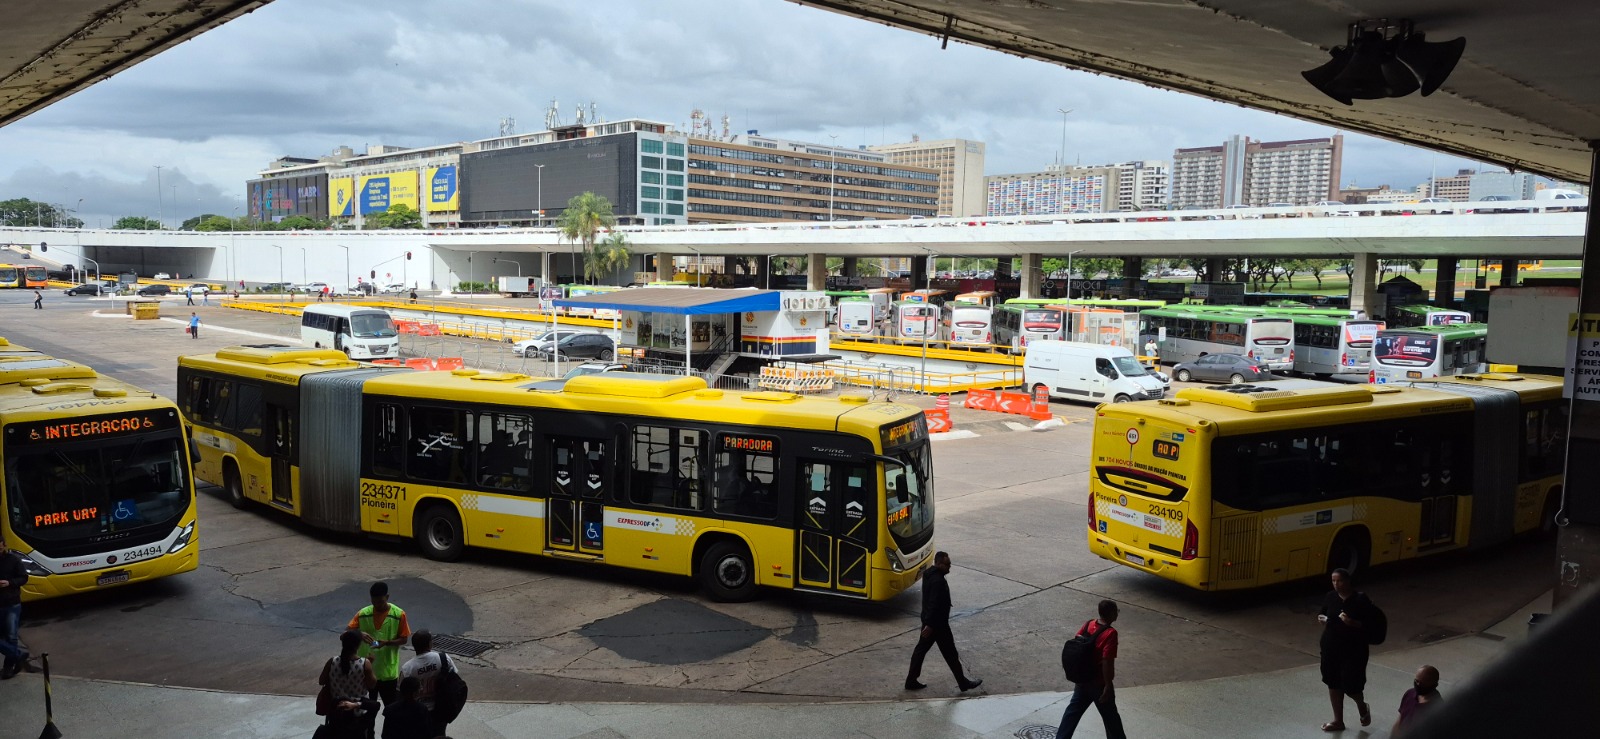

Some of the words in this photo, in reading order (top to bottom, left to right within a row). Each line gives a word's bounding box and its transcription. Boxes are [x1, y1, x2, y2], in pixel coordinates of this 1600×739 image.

[1571, 318, 1600, 333] AT
[362, 482, 406, 501] 234371
[1096, 492, 1117, 504] Pioneira
[362, 498, 396, 510] Pioneira
[34, 511, 69, 527] PARK
[1149, 504, 1183, 521] 234109
[123, 545, 162, 561] 234494
